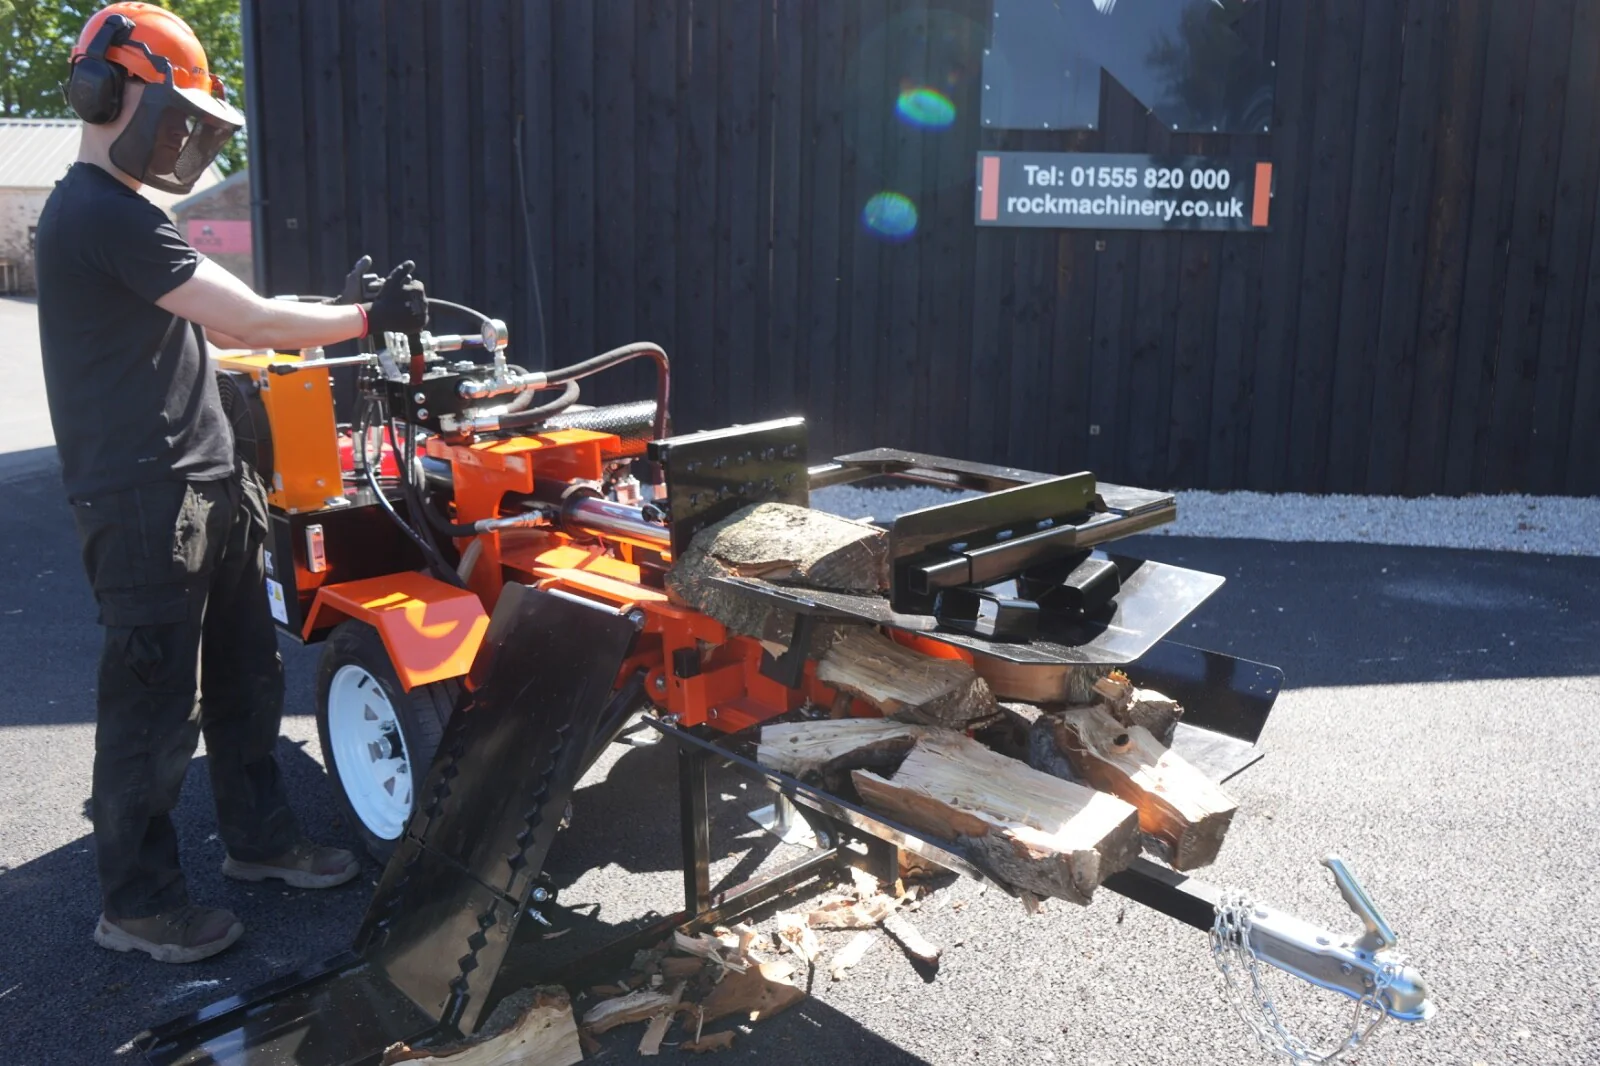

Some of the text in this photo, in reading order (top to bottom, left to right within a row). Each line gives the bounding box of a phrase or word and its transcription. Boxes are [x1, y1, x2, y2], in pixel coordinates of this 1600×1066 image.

[1023, 165, 1231, 190] Tel: 01555 820 000
[1007, 193, 1244, 221] rockmachinery.co.uk
